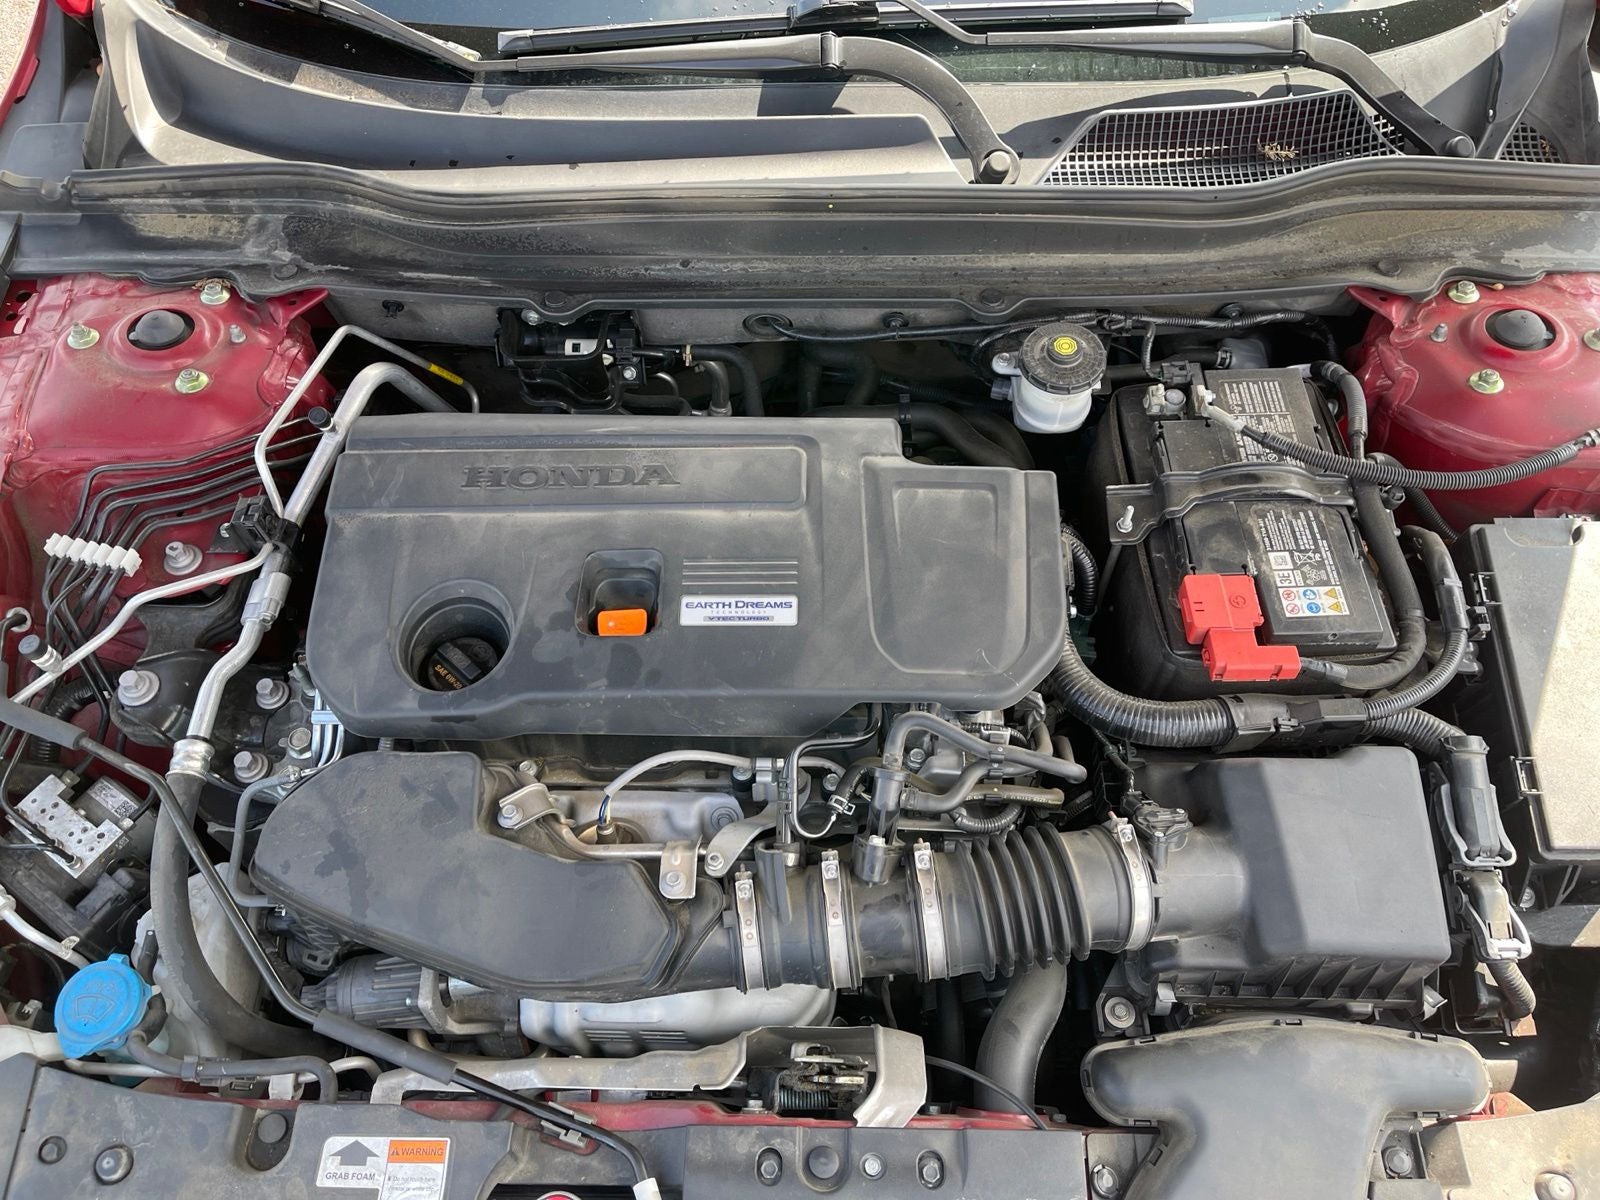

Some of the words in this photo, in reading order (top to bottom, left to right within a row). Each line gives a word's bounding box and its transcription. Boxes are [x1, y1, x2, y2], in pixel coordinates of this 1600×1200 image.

[461, 464, 681, 490] HONDA
[1278, 572, 1293, 585] 3E
[685, 601, 732, 609] EARTH
[735, 600, 793, 609] DREAMS
[434, 664, 448, 677] SAE
[401, 1147, 444, 1156] WARNING
[325, 1171, 349, 1180] GRAB
[351, 1172, 376, 1181] FOAM
